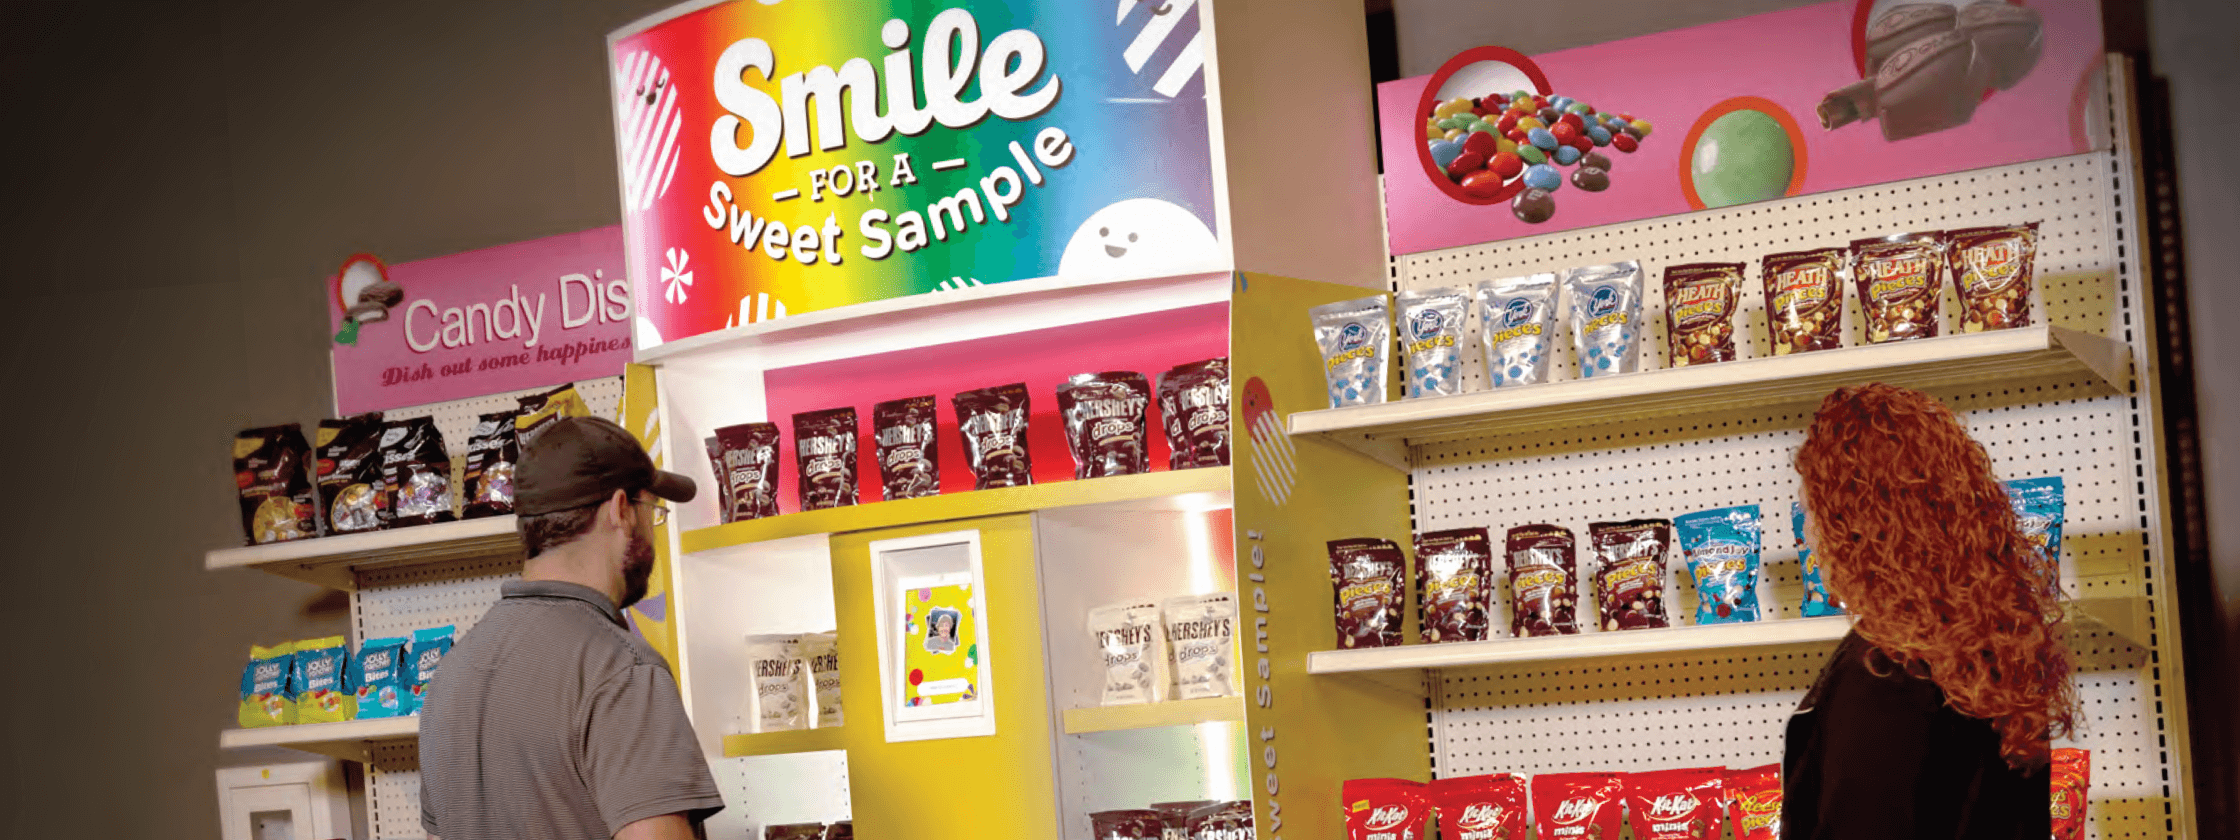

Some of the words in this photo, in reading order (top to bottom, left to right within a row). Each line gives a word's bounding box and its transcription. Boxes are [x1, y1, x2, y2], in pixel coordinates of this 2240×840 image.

[709, 7, 1061, 176] Smile
[810, 158, 878, 202] FOR
[890, 153, 917, 186] A
[703, 181, 844, 265] Sweet
[860, 126, 1075, 259] Sample
[1777, 267, 1828, 291] HEATH
[1871, 258, 1927, 279] HEATH
[1678, 283, 1726, 304] HEATH
[1774, 286, 1825, 311] pieces
[1871, 275, 1925, 299] pieces
[404, 284, 546, 352] Candy
[559, 269, 631, 329] Dis
[1675, 301, 1723, 324] pieces
[1409, 335, 1455, 355] ieces
[381, 363, 434, 386] Dish
[440, 357, 473, 378] out
[478, 352, 530, 372] some
[535, 336, 631, 363] happines
[1327, 345, 1375, 373] pieces
[1092, 420, 1135, 441] drops
[1188, 411, 1227, 431] drops
[887, 449, 921, 467] drops
[1606, 562, 1657, 590] pieces
[1695, 559, 1746, 586] piees
[1340, 582, 1391, 607] pieces
[1172, 618, 1231, 642] HERSHEY'S
[1248, 530, 1273, 708] Sample!
[1180, 643, 1218, 664] drops
[1366, 805, 1407, 825] KitKat
[1651, 794, 1696, 815] KitKat
[1554, 825, 1586, 837] minis
[1652, 822, 1689, 833] minis
